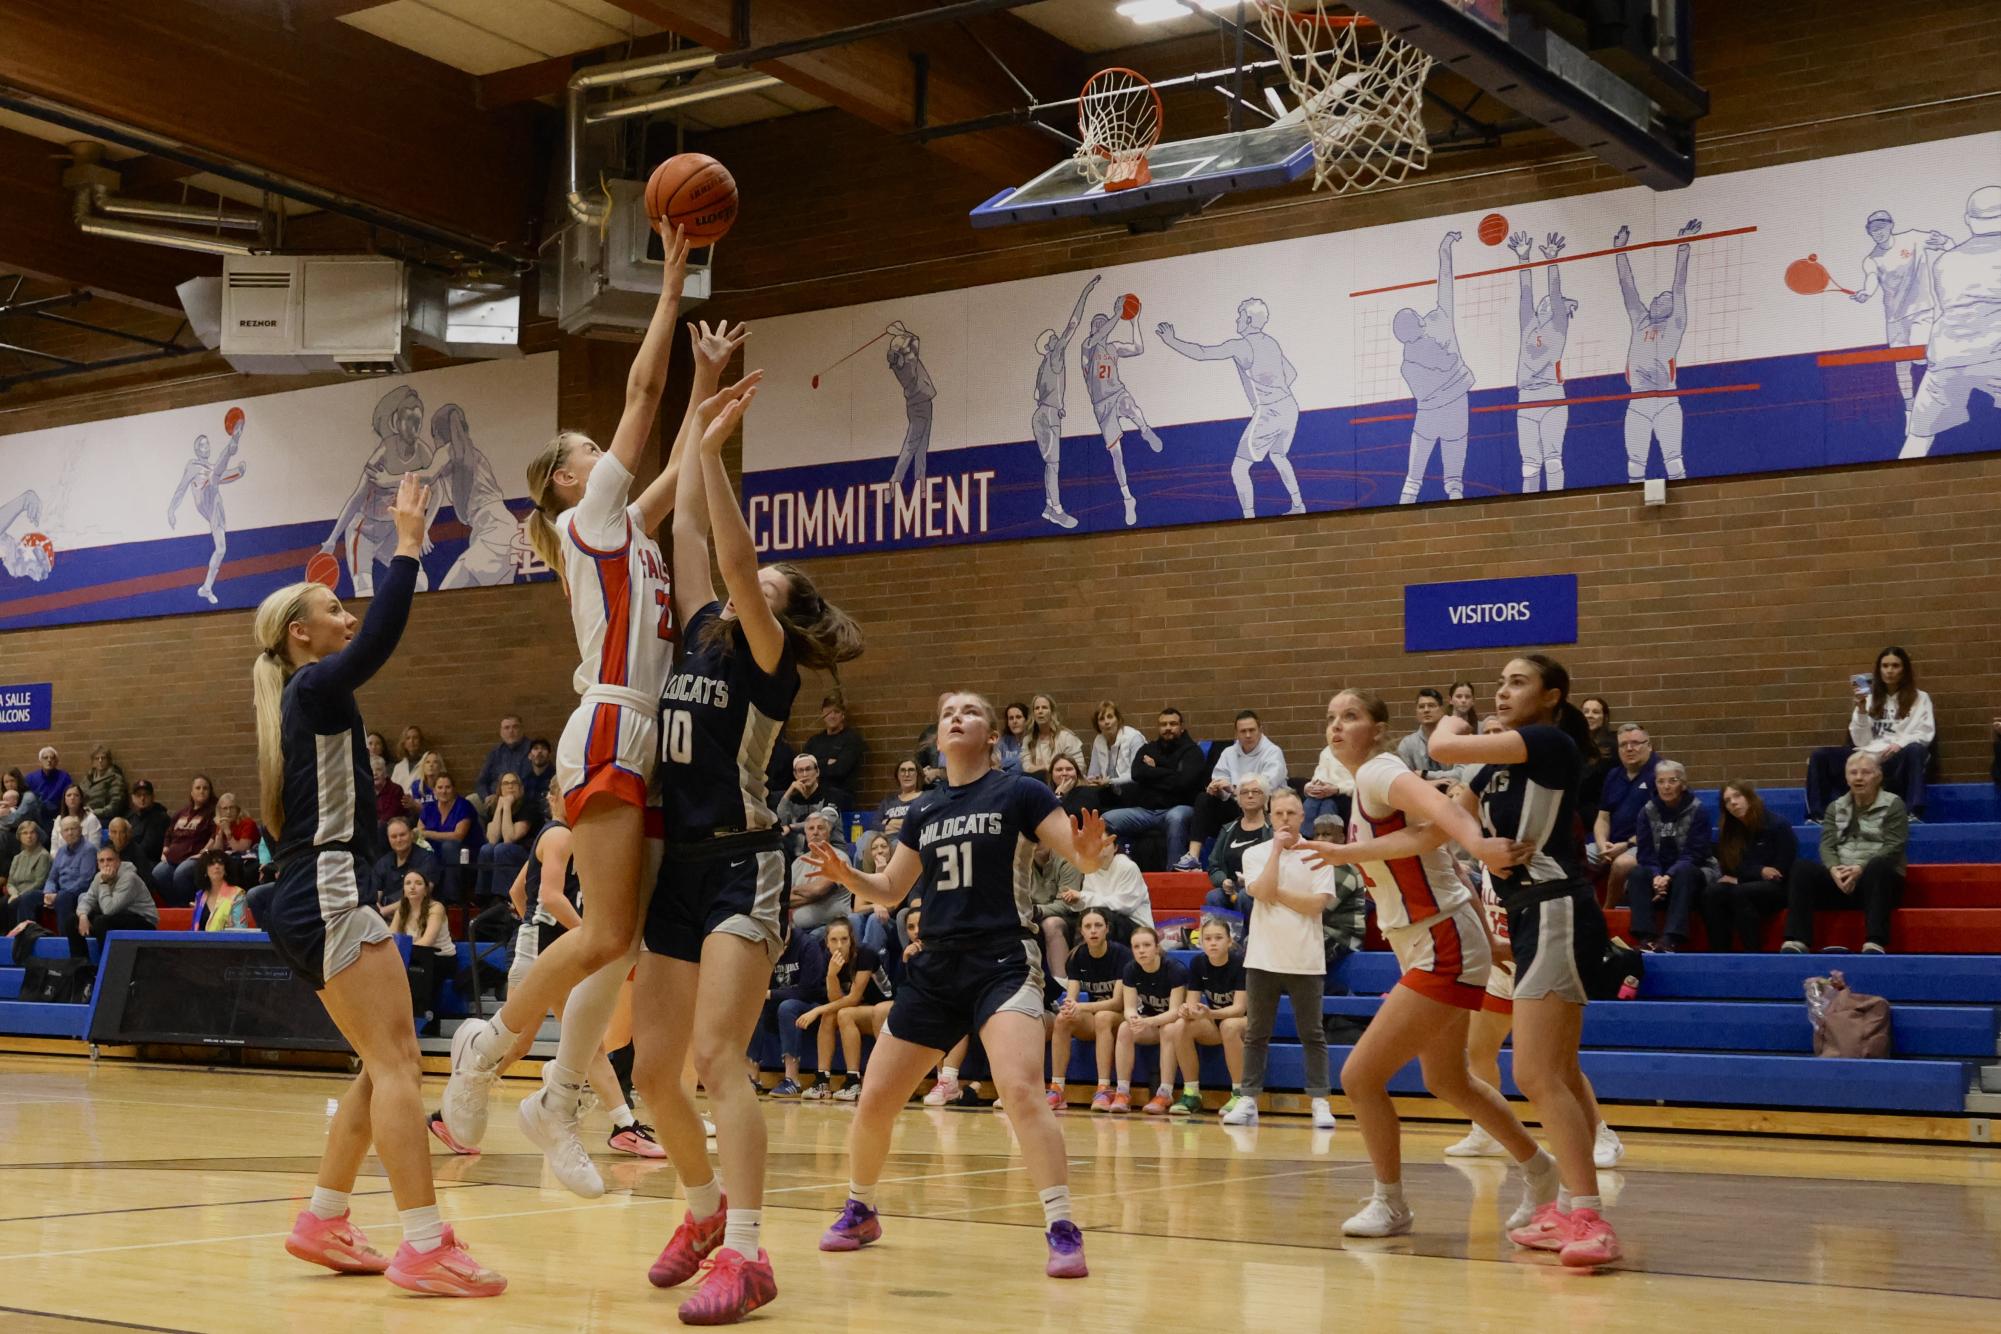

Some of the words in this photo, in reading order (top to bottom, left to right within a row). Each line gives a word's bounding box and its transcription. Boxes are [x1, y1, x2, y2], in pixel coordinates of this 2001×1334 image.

[239, 320, 278, 328] REZNOR
[1098, 364, 1111, 379] 21
[749, 470, 995, 553] COMMITMENT
[1448, 601, 1531, 625] VISITORS
[5, 692, 31, 706] SALLE
[661, 708, 692, 765] 10
[918, 812, 1003, 850] WILDCATS
[935, 841, 973, 892] 31
